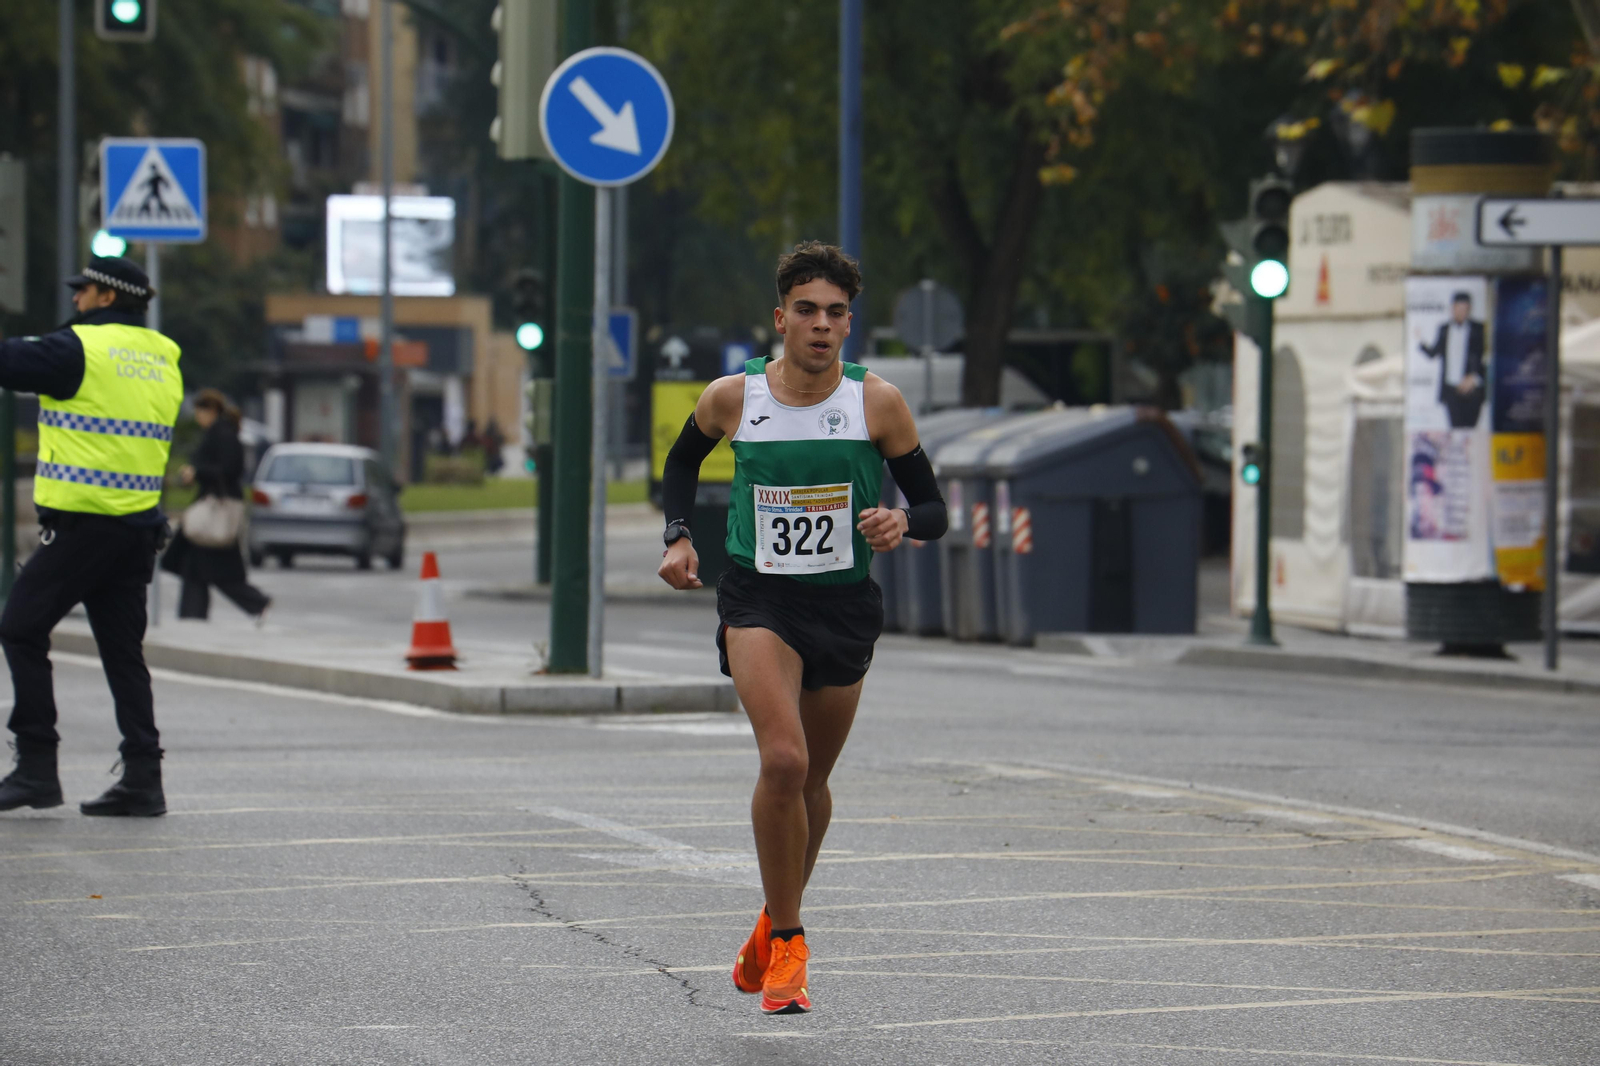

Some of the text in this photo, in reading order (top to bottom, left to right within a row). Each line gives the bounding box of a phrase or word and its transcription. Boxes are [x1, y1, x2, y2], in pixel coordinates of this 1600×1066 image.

[109, 347, 167, 366] POLICIA
[117, 364, 165, 383] LOCAL
[758, 489, 790, 504] XXXIX
[807, 502, 848, 511] TRINITARIOS
[772, 515, 833, 555] 322
